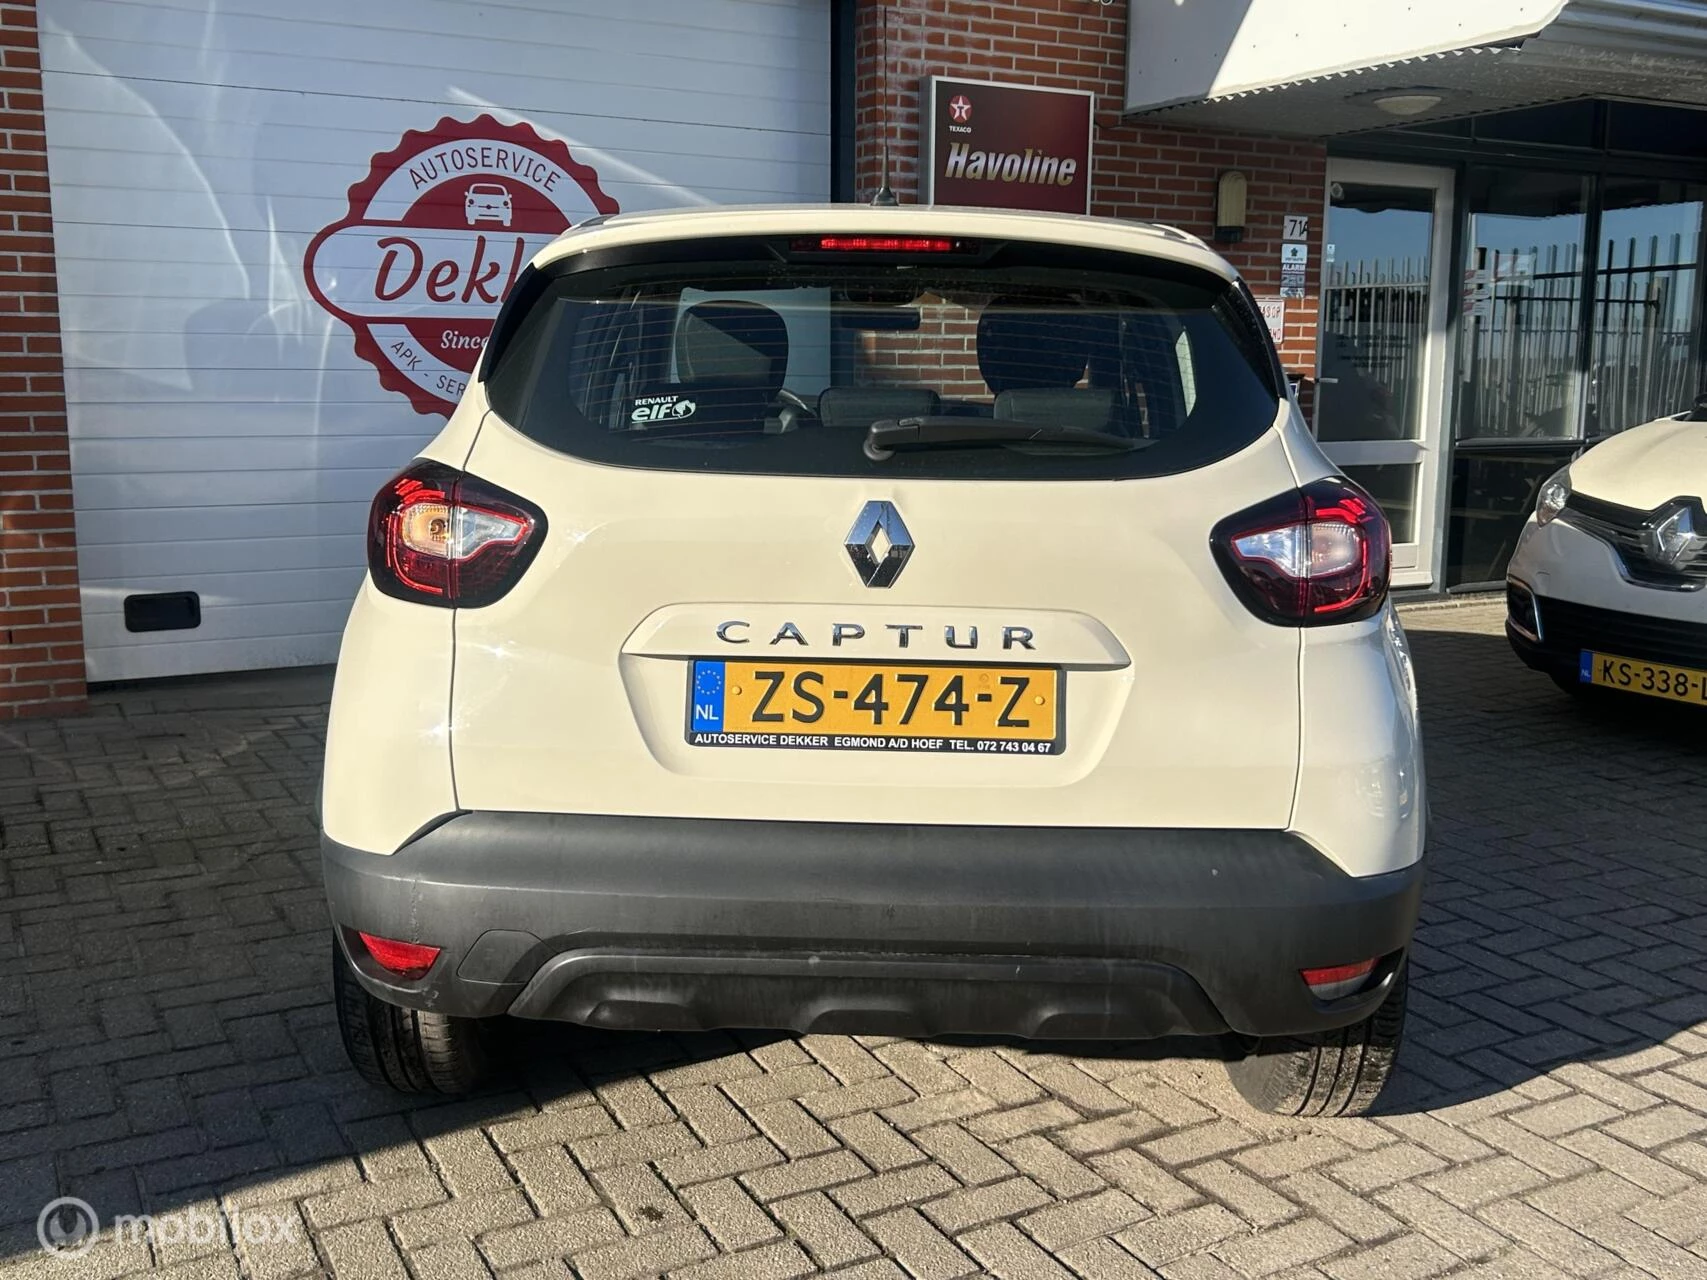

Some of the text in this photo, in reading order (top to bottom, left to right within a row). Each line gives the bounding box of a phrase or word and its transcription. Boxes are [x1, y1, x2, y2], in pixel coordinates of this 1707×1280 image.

[948, 125, 972, 134] TEXACO
[408, 147, 561, 193] AUTOSERVICE
[944, 142, 1077, 187] Havoline
[390, 341, 423, 372] APK
[634, 395, 679, 406] RENAULT
[716, 620, 1036, 650] CAPTUR
[1581, 669, 1591, 678] NL
[695, 704, 719, 720] NL
[751, 671, 1031, 728] ZS-474-Z
[694, 733, 1052, 753] AUTOSERVICE DEKKER EGMOND A/D HOEF TEL. 072 743 04 67
